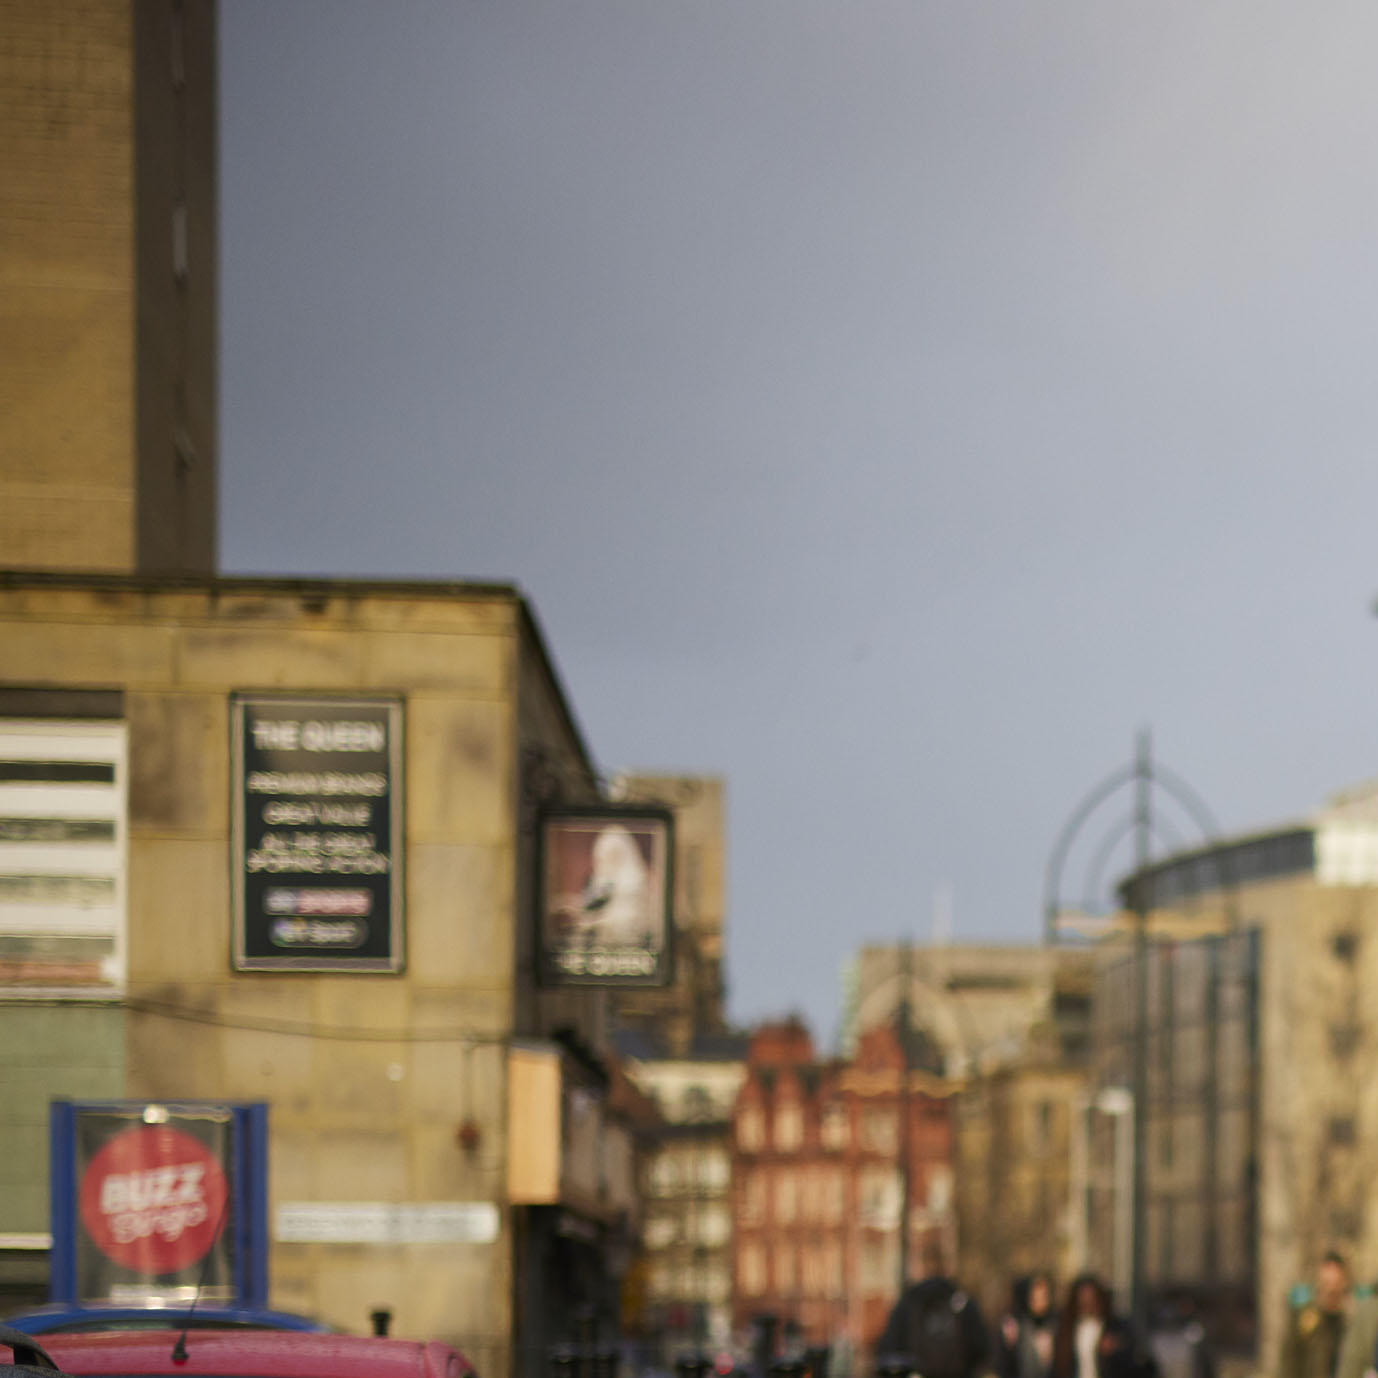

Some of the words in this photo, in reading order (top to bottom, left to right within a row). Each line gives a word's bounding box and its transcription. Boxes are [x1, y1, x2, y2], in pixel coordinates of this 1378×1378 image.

[252, 720, 300, 750] THE
[302, 720, 385, 751] QUEEN
[101, 1161, 206, 1215] BUZZ
